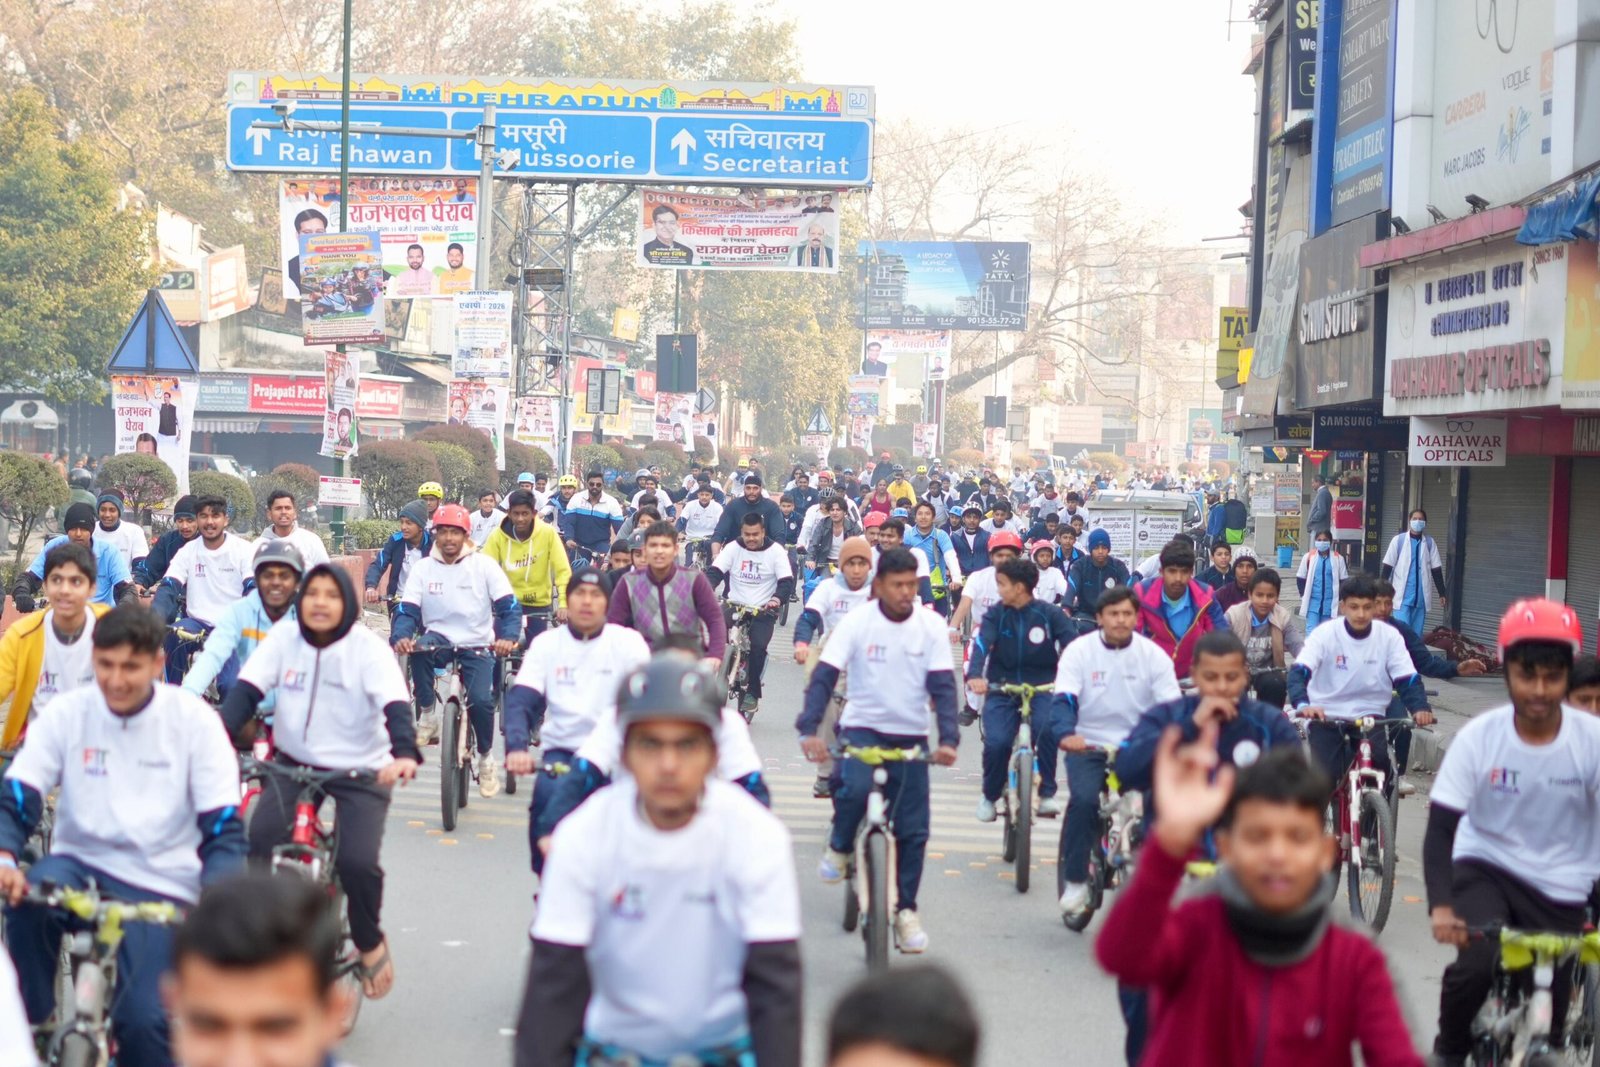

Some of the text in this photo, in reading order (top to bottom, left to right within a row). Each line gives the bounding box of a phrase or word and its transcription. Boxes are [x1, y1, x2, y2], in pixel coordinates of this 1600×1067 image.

[1502, 66, 1531, 91] VOGUE
[452, 92, 659, 110] DEHRADUN
[1342, 74, 1373, 112] TABLETS
[1445, 90, 1487, 125] CARRERA
[502, 117, 567, 151] मसूरी
[704, 122, 826, 151] सचिवालय
[279, 143, 318, 168] Raj
[703, 153, 849, 175] Secretariat
[1443, 147, 1486, 178] MARC JACOBS
[349, 202, 427, 222] राजभवन
[682, 222, 724, 236] किसानों
[727, 222, 742, 236] की
[745, 225, 799, 238] आत्महत्या
[696, 244, 790, 255] राजभवन घेराव
[1391, 338, 1551, 399] MAHAWAR OPTICALS
[253, 384, 296, 401] Prajapati
[297, 385, 317, 399] Fast
[117, 406, 152, 417] राजभवन
[1320, 415, 1373, 428] SAMSUNG
[1416, 434, 1502, 448] MAHAWAR
[1424, 449, 1494, 461] OPTICALS
[741, 560, 762, 573] FIT
[740, 572, 762, 580] INDIA
[83, 748, 109, 764] FIT
[1491, 767, 1521, 786] FIT
